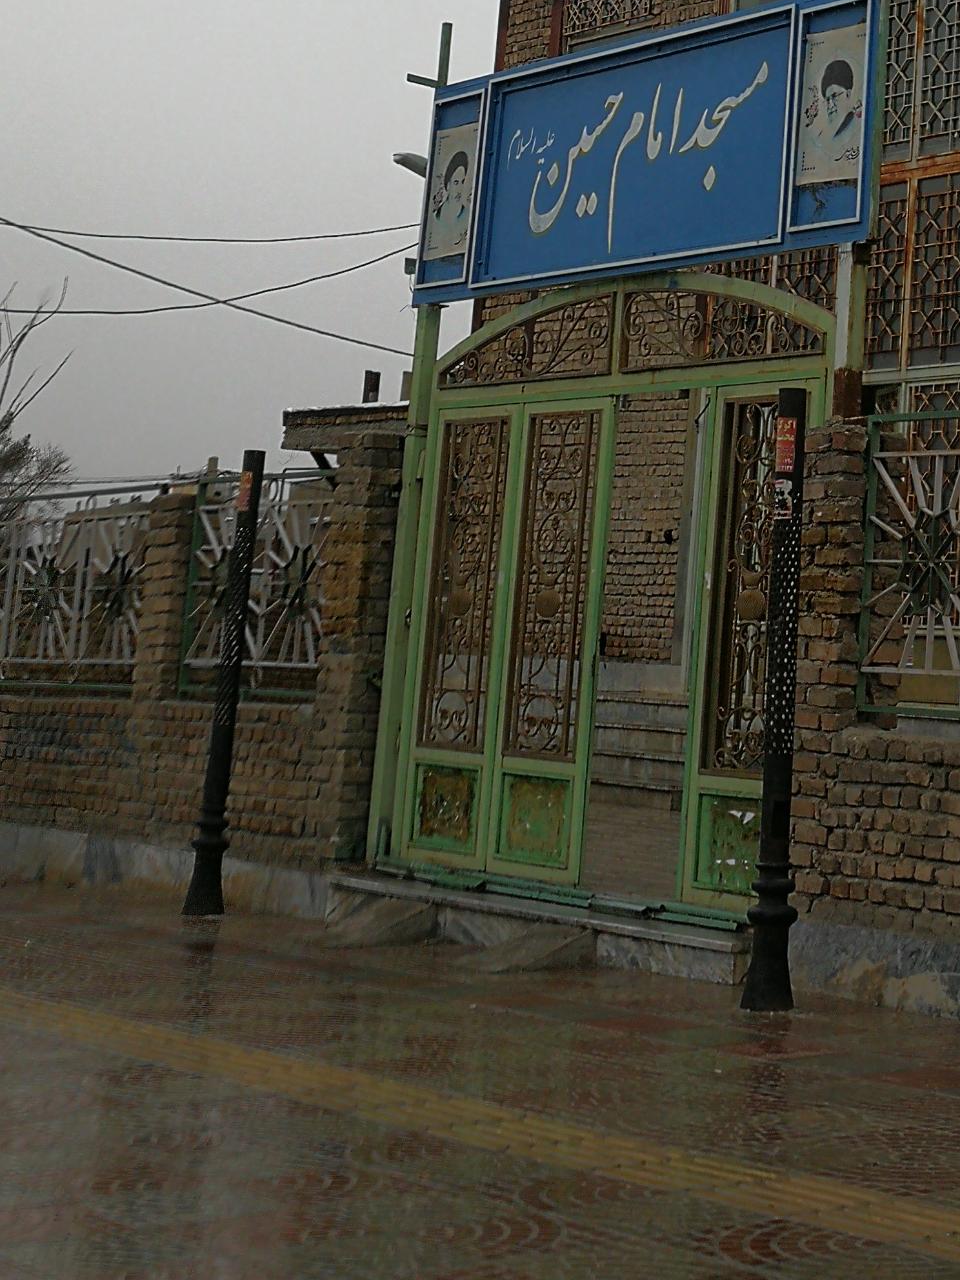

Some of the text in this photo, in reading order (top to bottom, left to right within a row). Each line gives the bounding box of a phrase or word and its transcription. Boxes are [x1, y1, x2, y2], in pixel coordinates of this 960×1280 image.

[528, 61, 769, 255] مسجد امام حسین
